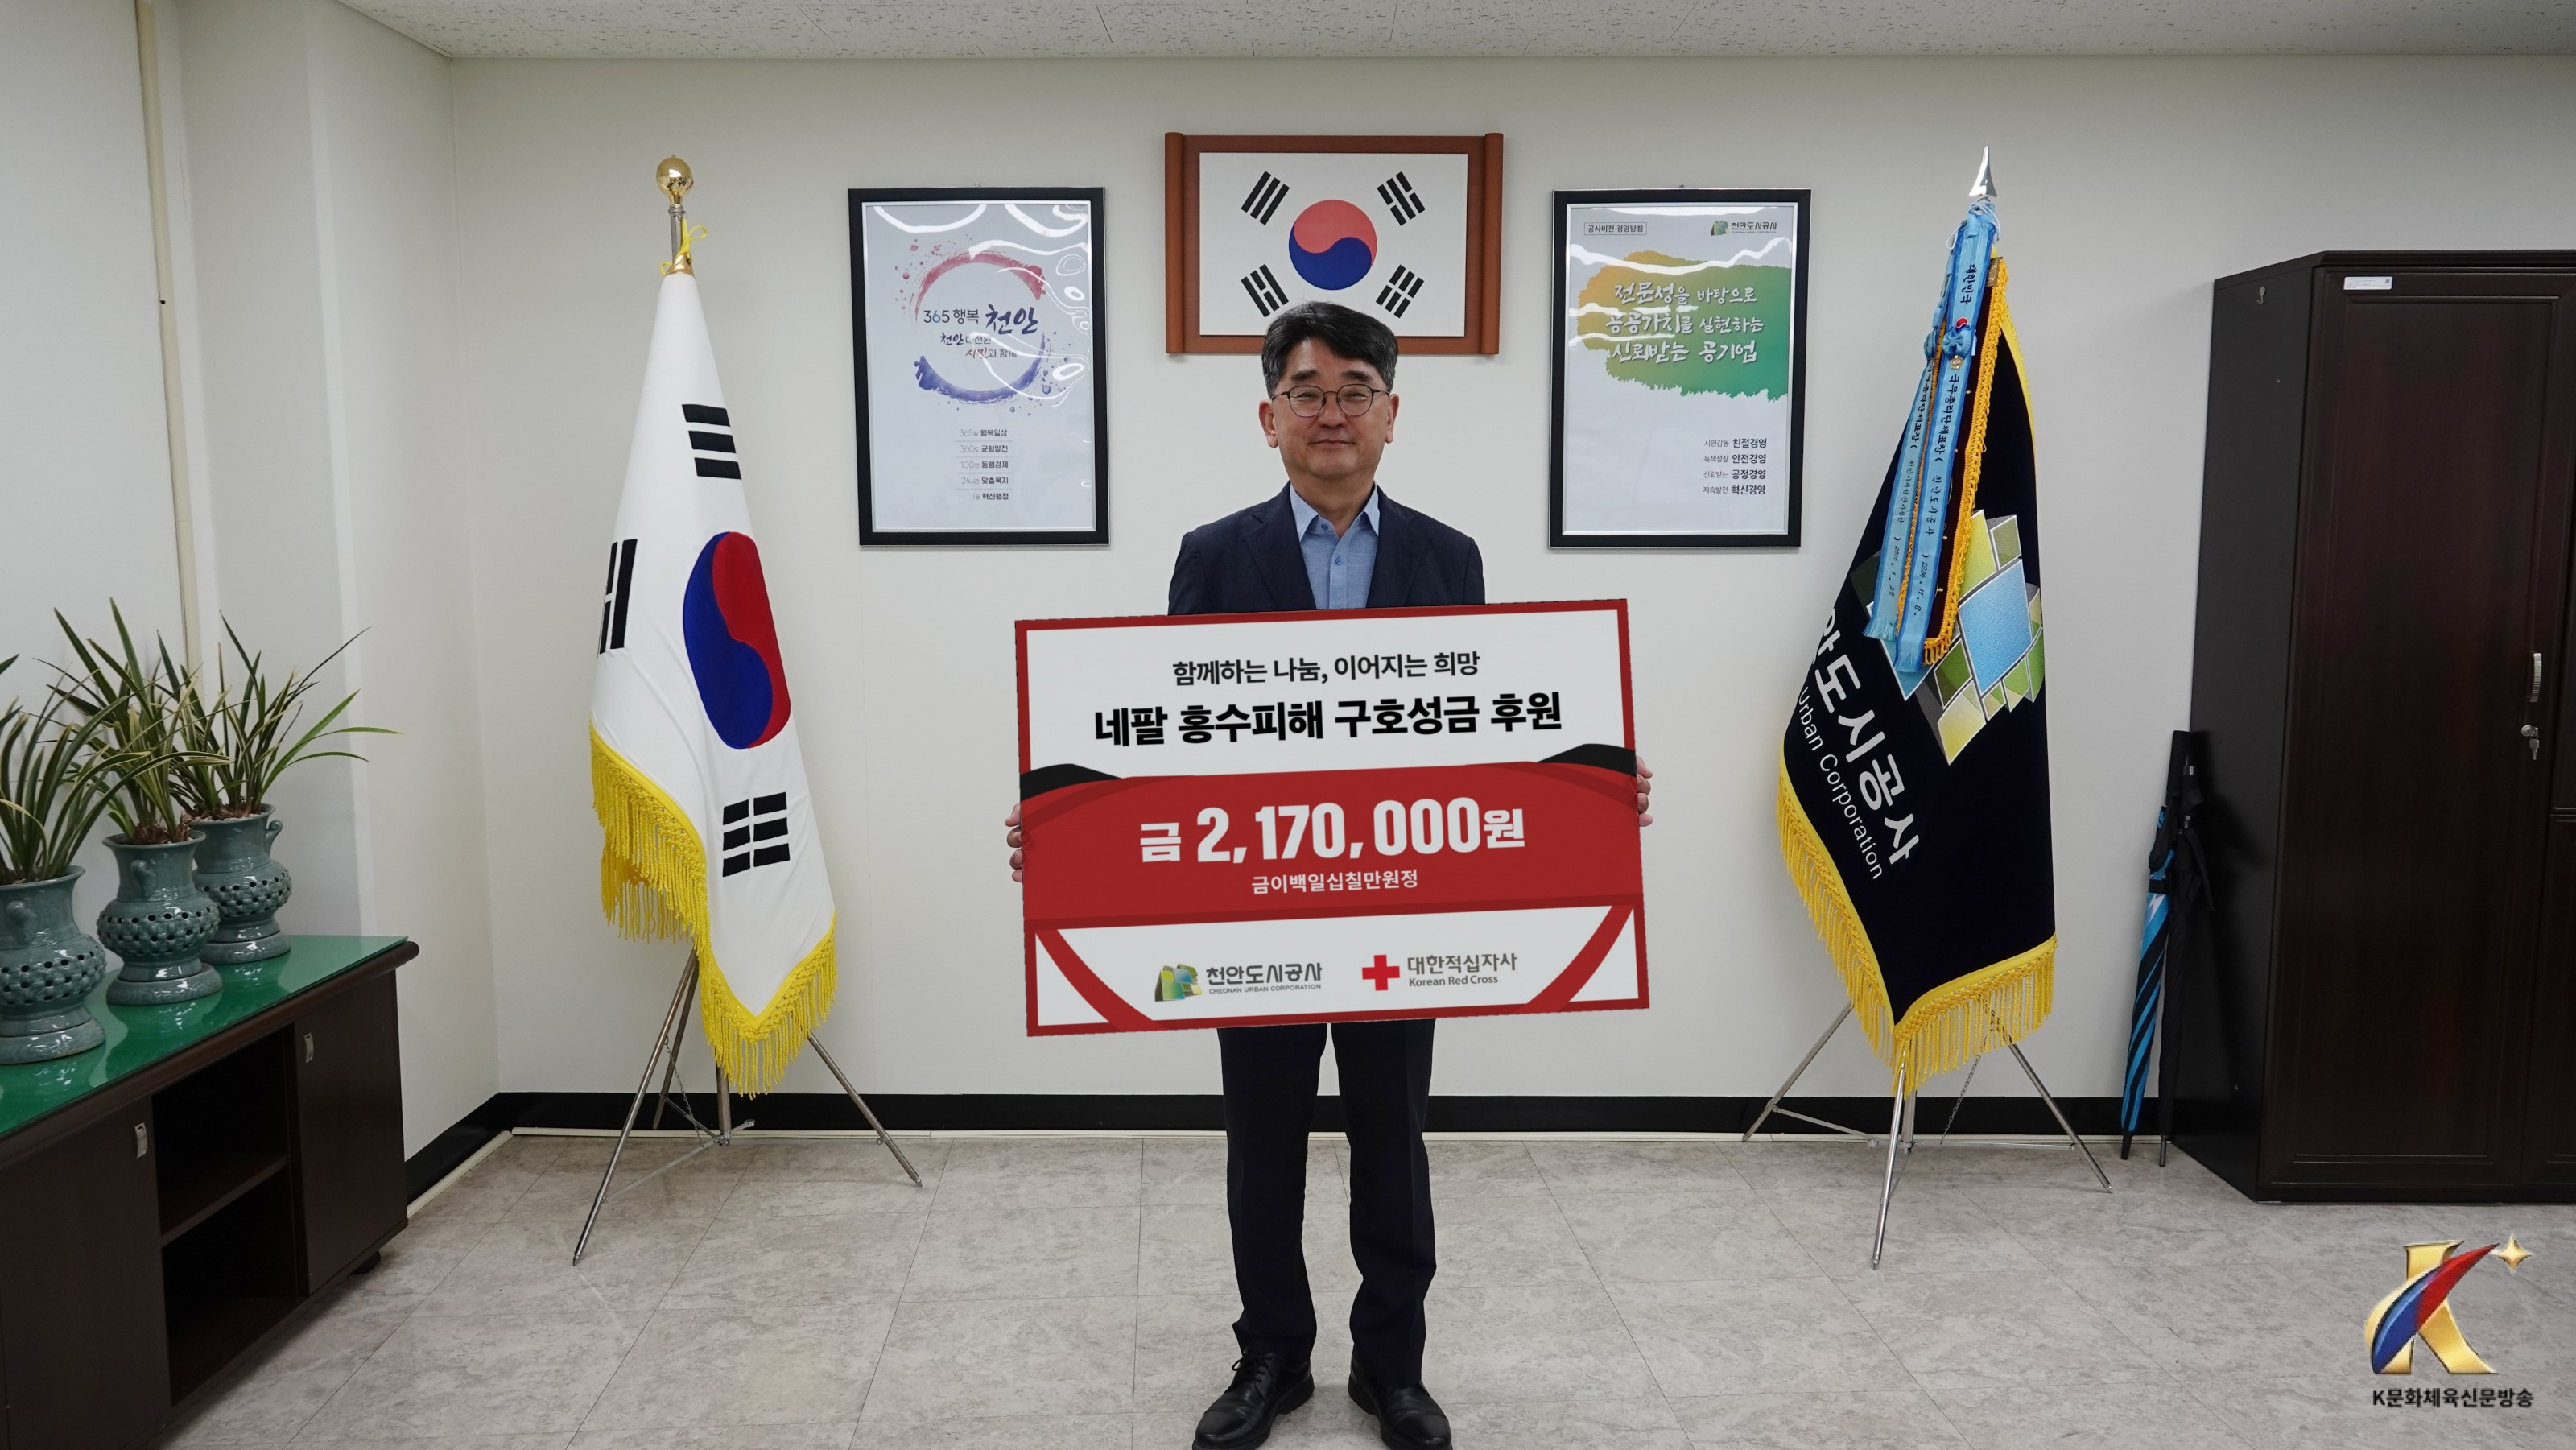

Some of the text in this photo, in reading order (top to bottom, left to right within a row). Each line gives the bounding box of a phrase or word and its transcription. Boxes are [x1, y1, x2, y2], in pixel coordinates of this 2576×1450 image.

[1587, 225, 1644, 233] 공사비전 경영방침
[1732, 221, 1777, 230] 천안도시공사
[1614, 282, 1757, 305] 전문성을 바탕으로
[1960, 264, 1977, 304] 대한민국
[923, 304, 1038, 334] 365 행복 천안
[1605, 312, 1764, 334] 공공가치를 실현하는
[1612, 340, 1757, 363] 신뢰받는 공기업
[1732, 438, 1767, 448] 친절경영
[1732, 453, 1766, 464] 안전경영
[1703, 469, 1765, 479] 신뢰받는 공정경영
[1731, 485, 1765, 495] 혁신경영
[1926, 475, 1942, 536] 천안도시공사
[1172, 651, 1480, 686] 함께하는 나눔, 이어지는 희망
[1094, 691, 1563, 747] 네팔 홍수피해 구호성금 후원
[1798, 686, 1883, 880] Urban Corporation
[1140, 821, 1182, 863] 금
[1251, 869, 1418, 894] 금이백일십칠만원정
[1206, 962, 1323, 986] 천안도시공사
[1407, 952, 1518, 975] 대한적십자사
[1270, 984, 1322, 992] CORPORATION
[1409, 974, 1499, 987] Korean Red Cross
